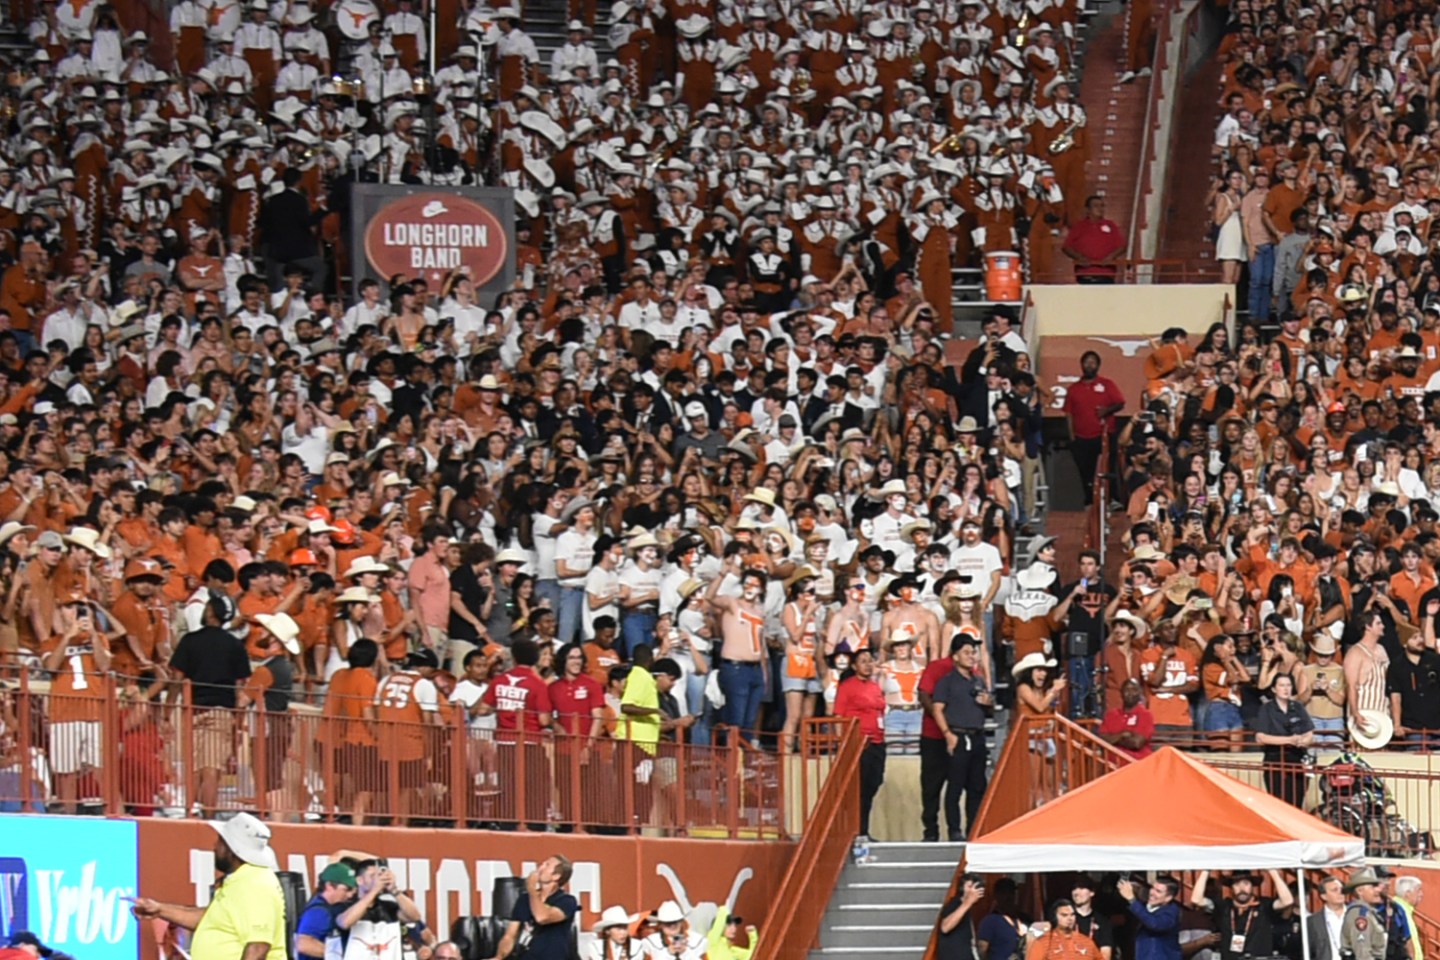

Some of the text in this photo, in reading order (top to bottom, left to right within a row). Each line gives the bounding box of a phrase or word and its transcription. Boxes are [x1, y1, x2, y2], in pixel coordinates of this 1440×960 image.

[384, 222, 488, 248] LONGHORN
[411, 246, 462, 271] BAND
[1012, 592, 1048, 602] TEXAS
[69, 655, 88, 690] 1
[495, 684, 530, 700] EVENT
[34, 859, 130, 945] Vrbo
